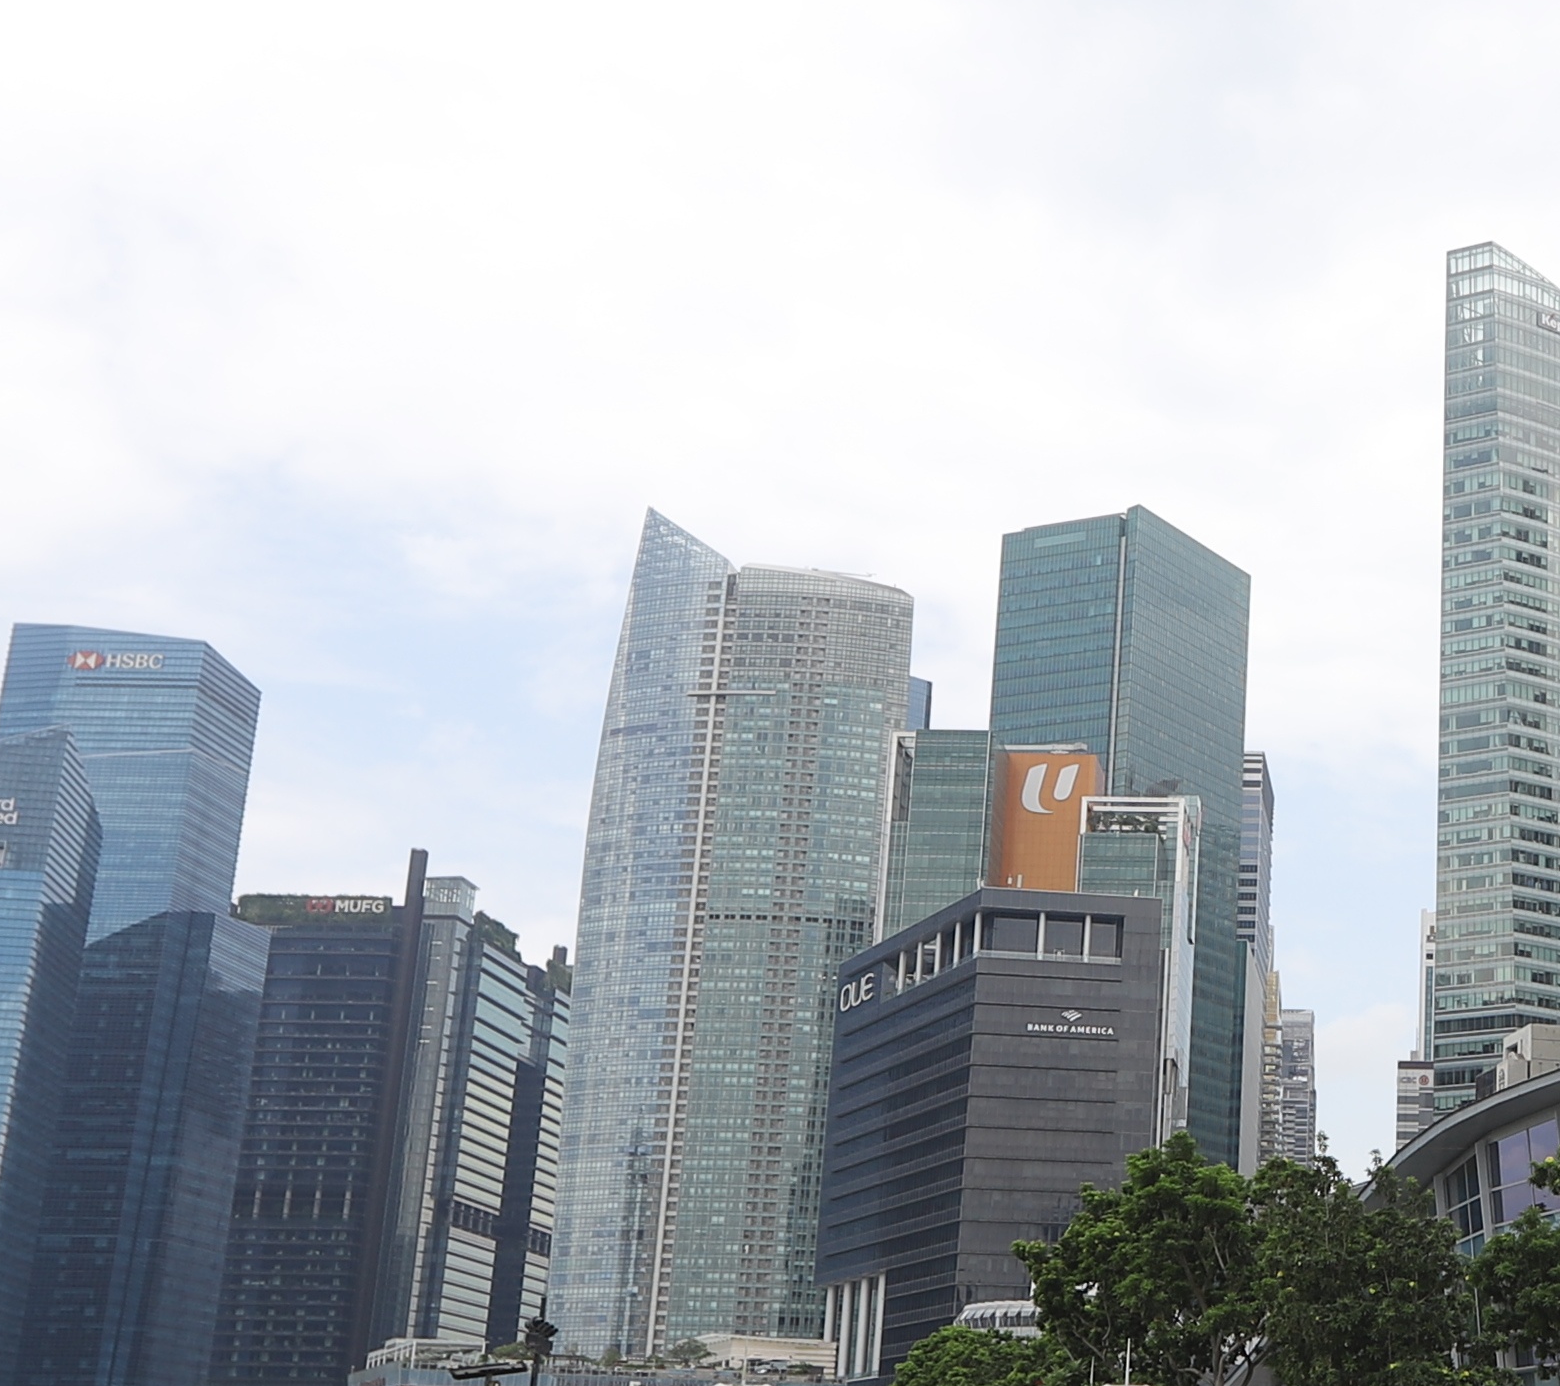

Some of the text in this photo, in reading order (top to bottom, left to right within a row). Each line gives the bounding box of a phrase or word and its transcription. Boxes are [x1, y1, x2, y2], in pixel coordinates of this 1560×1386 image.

[104, 653, 164, 669] HSBC
[334, 899, 385, 914] MUFG
[1027, 1023, 1115, 1035] BANK OF AMERICA
